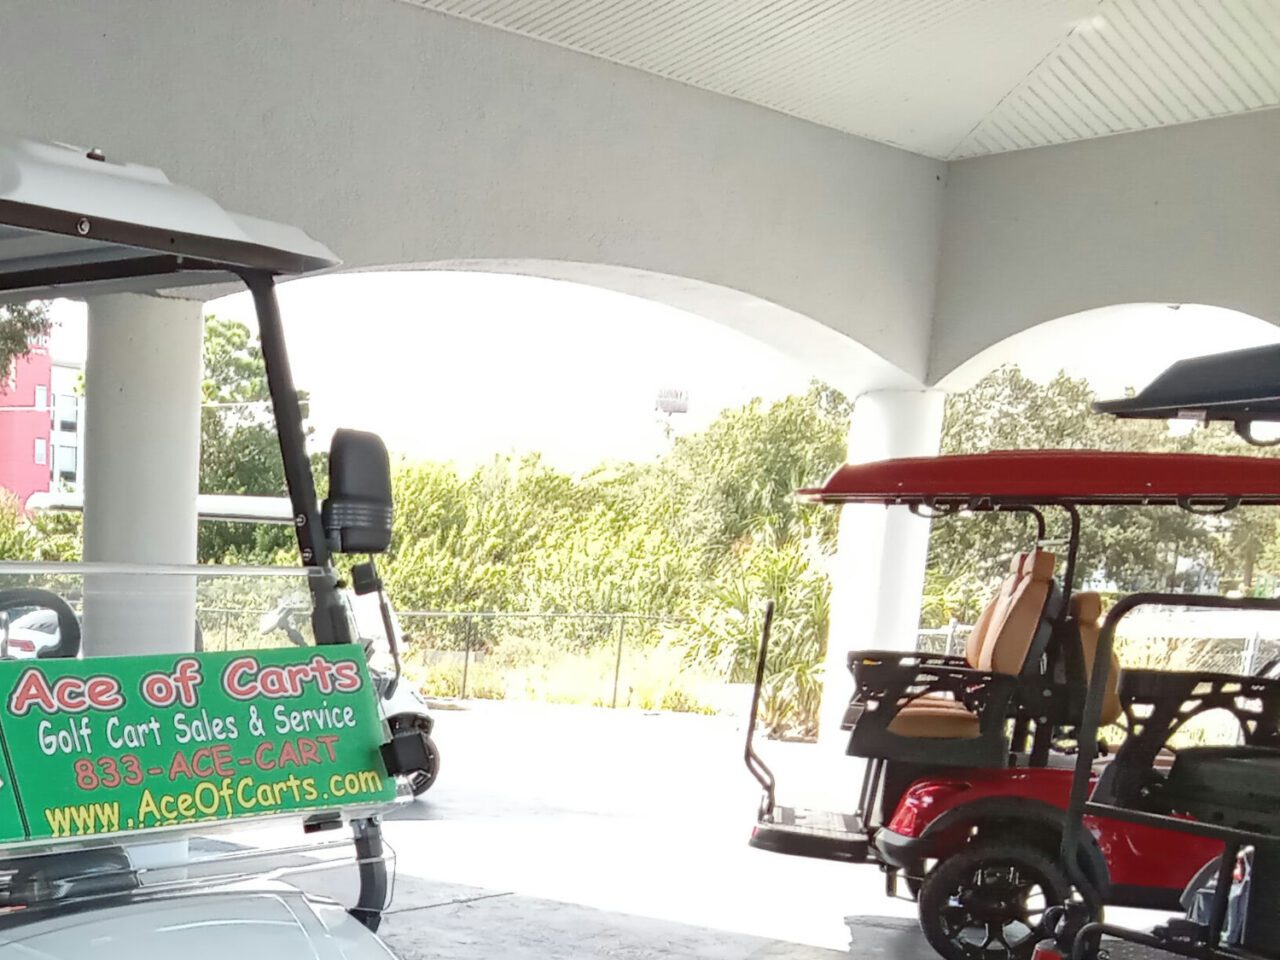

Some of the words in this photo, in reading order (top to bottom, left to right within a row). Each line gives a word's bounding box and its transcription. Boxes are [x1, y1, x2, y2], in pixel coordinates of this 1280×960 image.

[7, 667, 126, 716] Ace
[140, 657, 202, 708] of
[223, 654, 363, 702] Carts
[38, 716, 92, 756] Golf
[106, 716, 161, 749] Cart
[173, 708, 239, 744] Sales
[249, 704, 266, 737] &
[273, 700, 357, 735] Service
[74, 735, 340, 791] 833-ACE-CART
